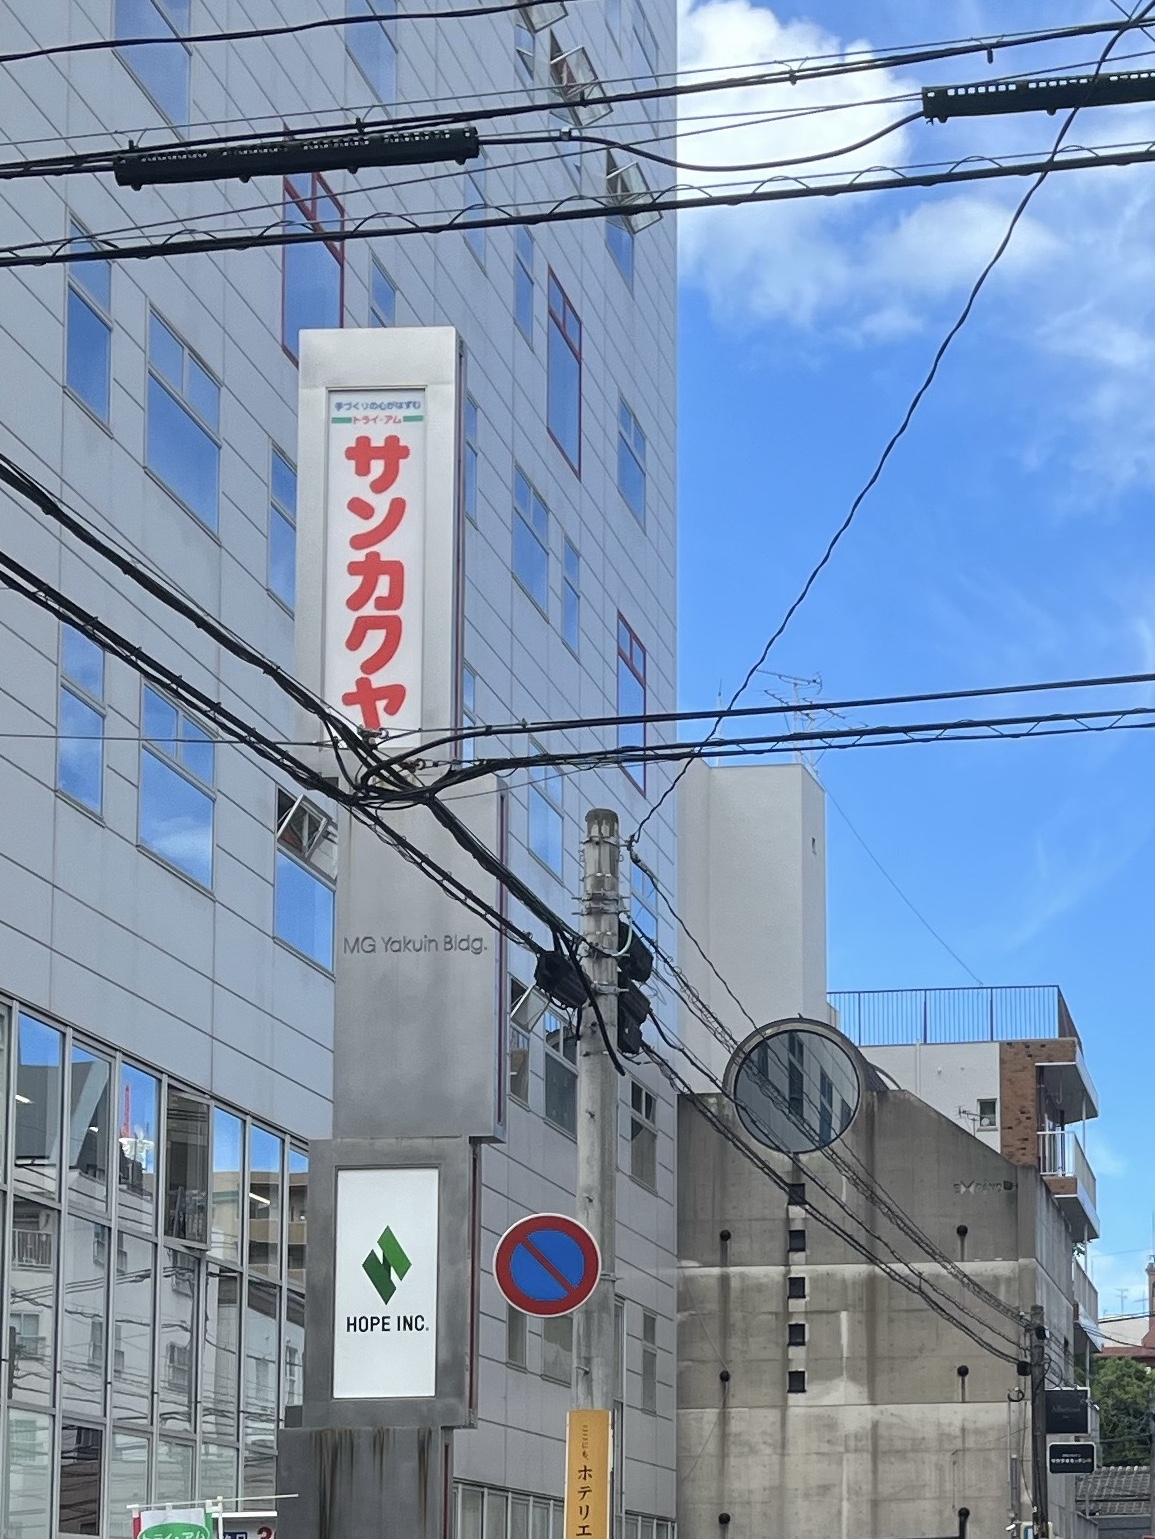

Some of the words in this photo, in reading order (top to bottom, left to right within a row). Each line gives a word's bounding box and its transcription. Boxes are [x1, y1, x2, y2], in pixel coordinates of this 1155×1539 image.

[342, 435, 410, 731] サンカクヤ
[343, 936, 376, 954] MG
[381, 934, 438, 953] Yakuin
[443, 934, 488, 955] Bldg.
[346, 1316, 391, 1333] HOPE
[397, 1315, 430, 1332] INC.
[576, 1464, 593, 1537] ホテリエ
